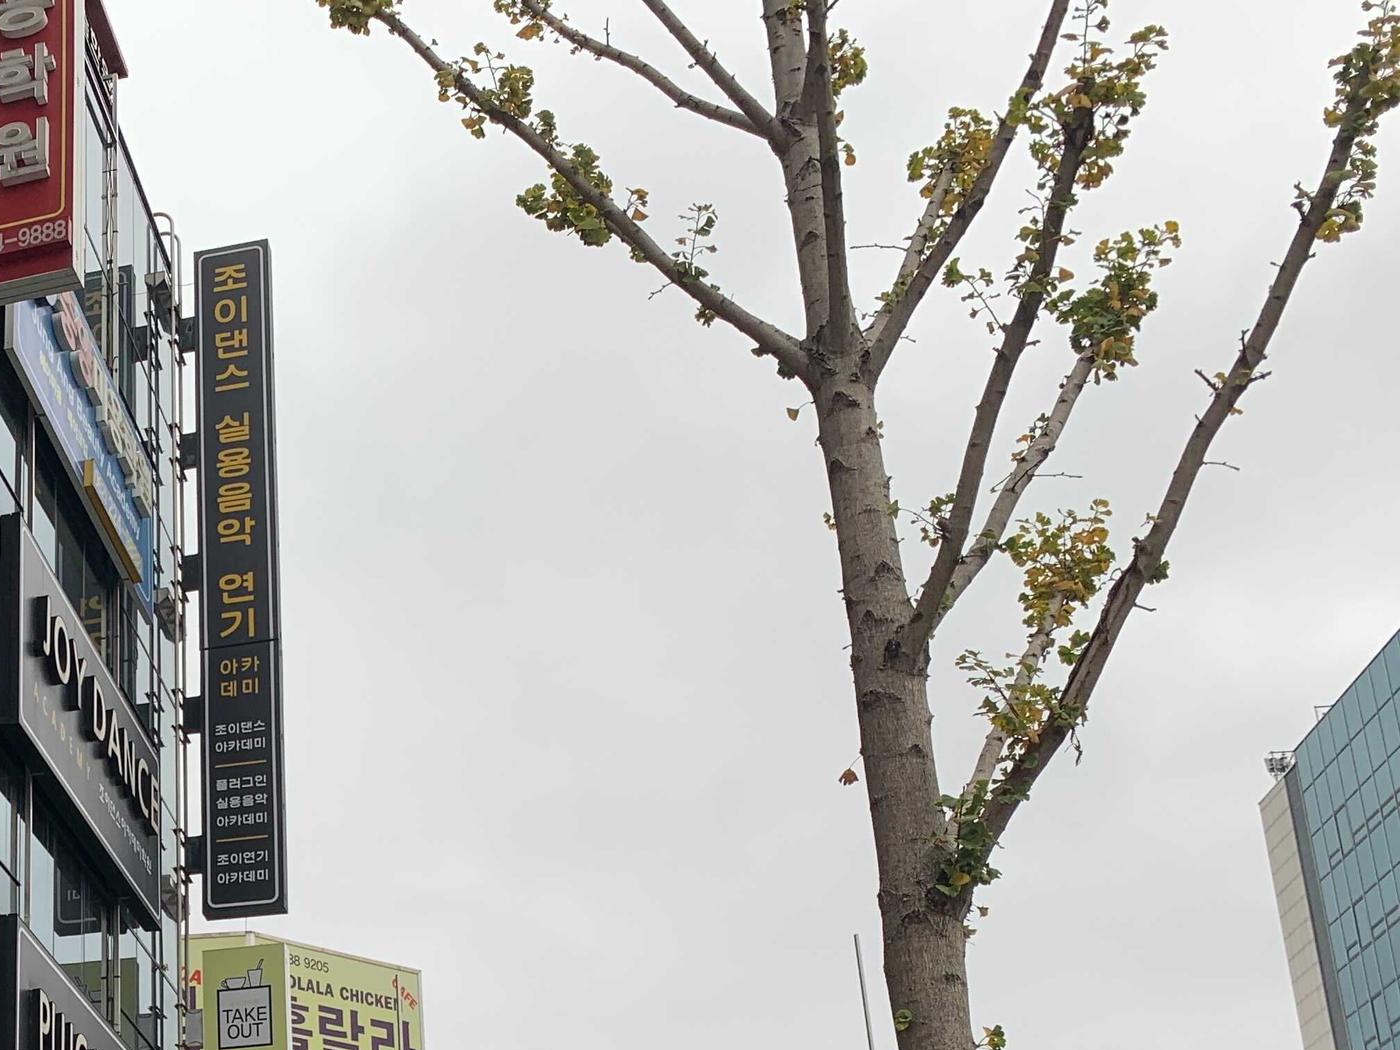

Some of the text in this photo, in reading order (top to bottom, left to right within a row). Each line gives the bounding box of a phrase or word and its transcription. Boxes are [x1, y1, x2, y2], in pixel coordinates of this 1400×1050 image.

[212, 263, 257, 638] 조이댄스 실용음악 연기
[219, 656, 261, 676] 아카
[220, 679, 261, 698] 데미
[43, 595, 160, 831] JOY DANCE
[33, 682, 92, 781] ACADEMY
[214, 720, 266, 735] 조이댄스
[214, 737, 268, 754] 아카데미
[215, 774, 268, 790] 플러그인
[216, 791, 269, 809] 실용음악
[216, 809, 269, 828] 아카데미
[217, 849, 270, 866] 조이연기
[217, 867, 270, 885] 아카데미
[303, 956, 330, 974] 9205
[340, 986, 403, 1012] CHICKEN
[222, 1005, 268, 1023] TAKE
[227, 1023, 264, 1040] OUT
